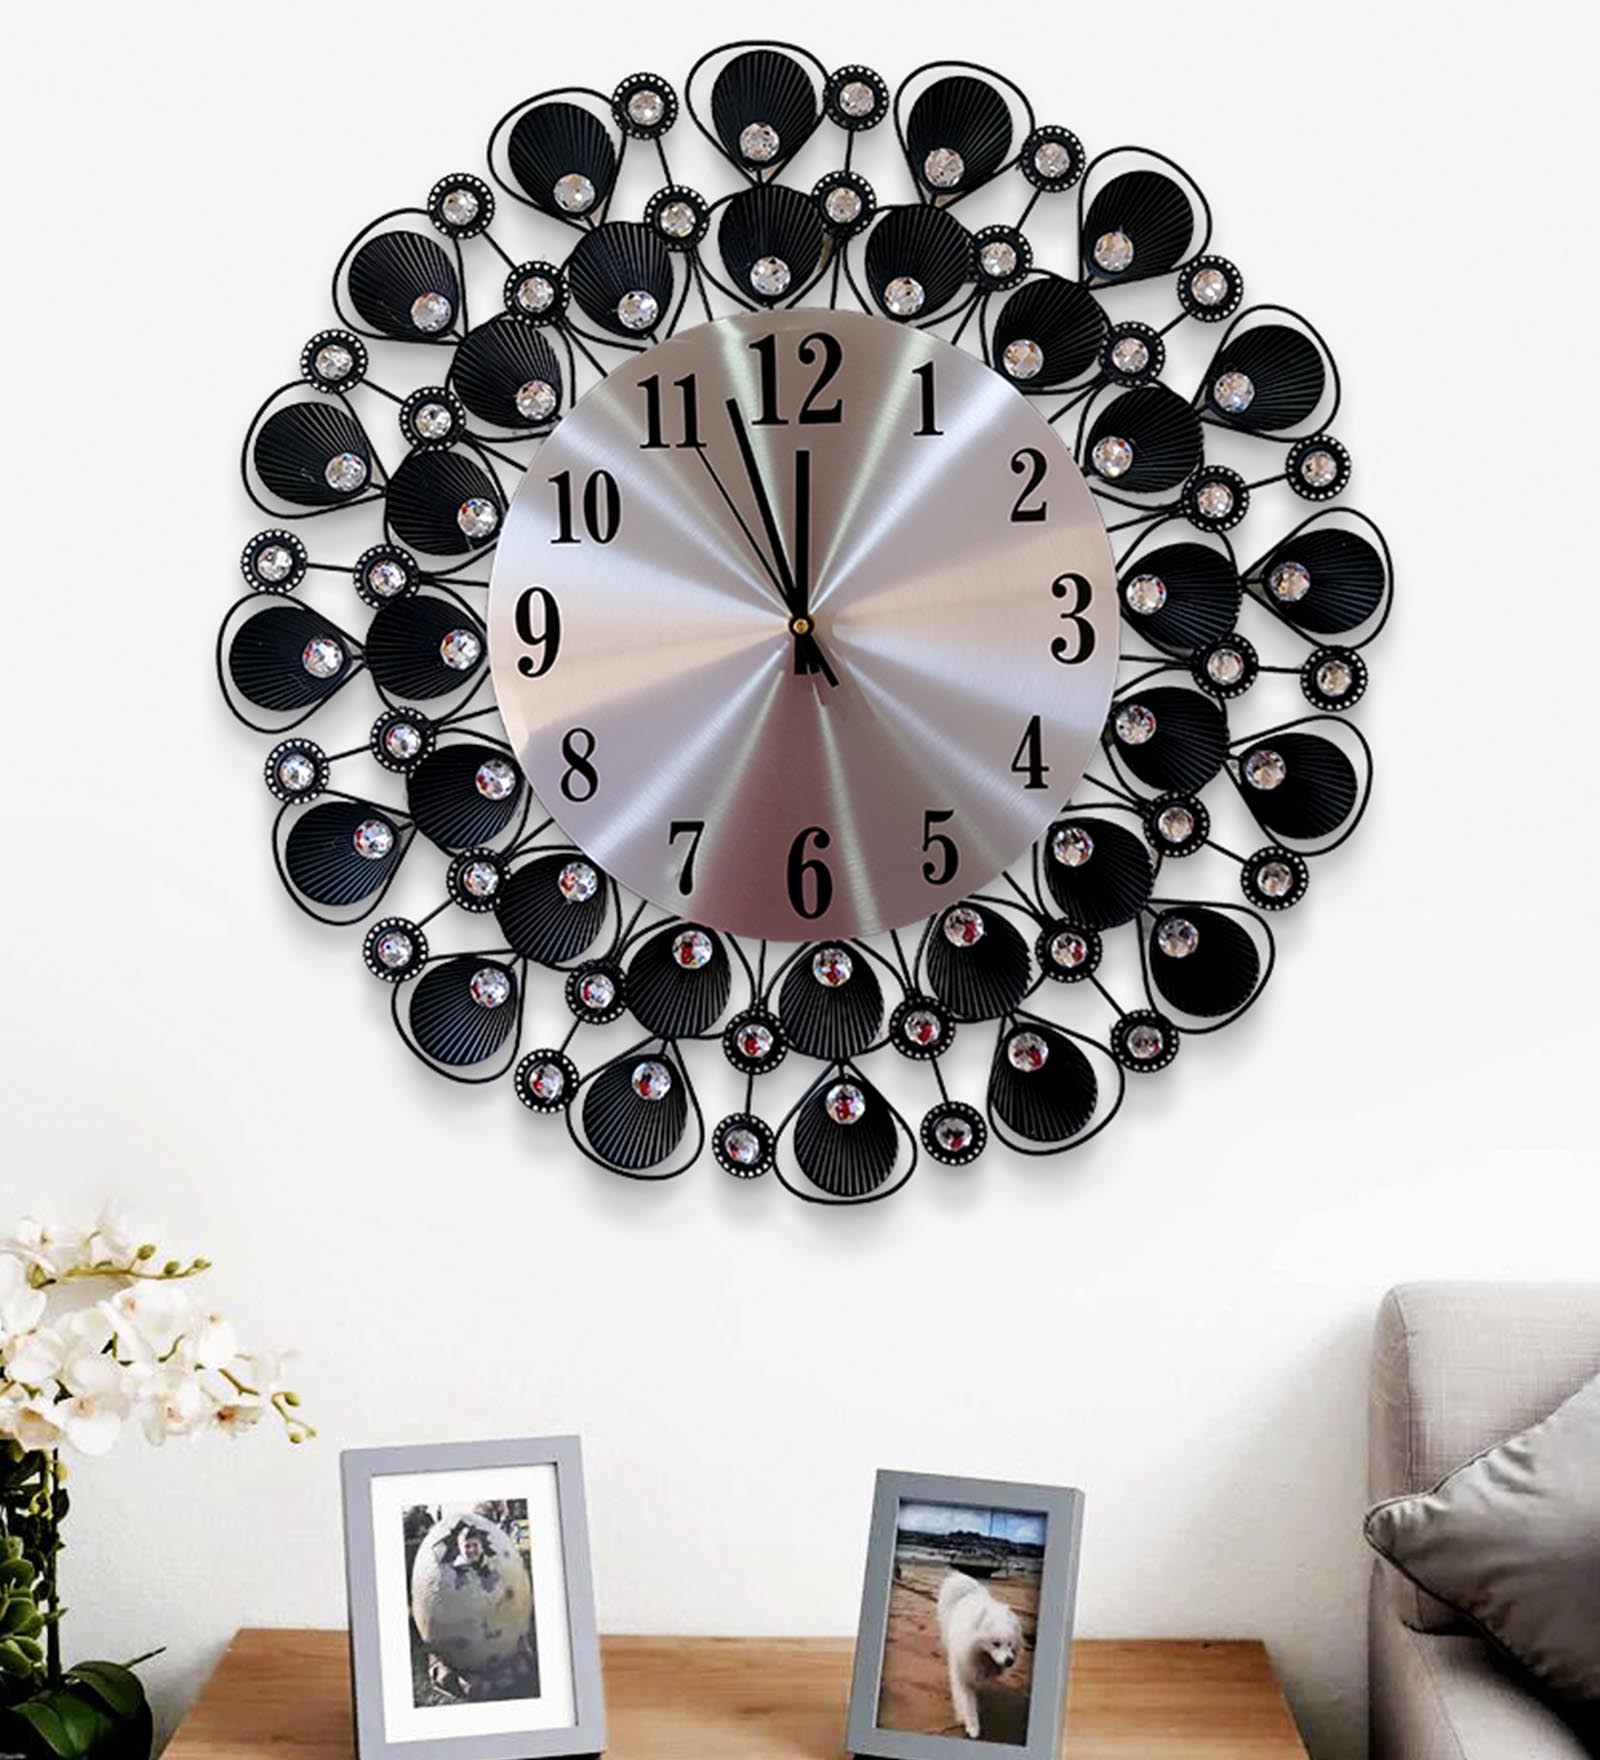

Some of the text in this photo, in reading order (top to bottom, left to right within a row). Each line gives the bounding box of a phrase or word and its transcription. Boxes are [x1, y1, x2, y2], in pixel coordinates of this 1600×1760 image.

[637, 373, 704, 450] 11
[749, 331, 844, 426] 12
[912, 361, 944, 436] 1
[548, 469, 622, 545] 10
[1010, 447, 1048, 523] 2
[515, 586, 561, 678] 9
[1050, 573, 1096, 665] 3
[560, 727, 599, 803] 8
[1011, 715, 1050, 790] 4
[668, 820, 705, 896] 7
[786, 826, 834, 921] 6
[921, 809, 959, 885] 5
